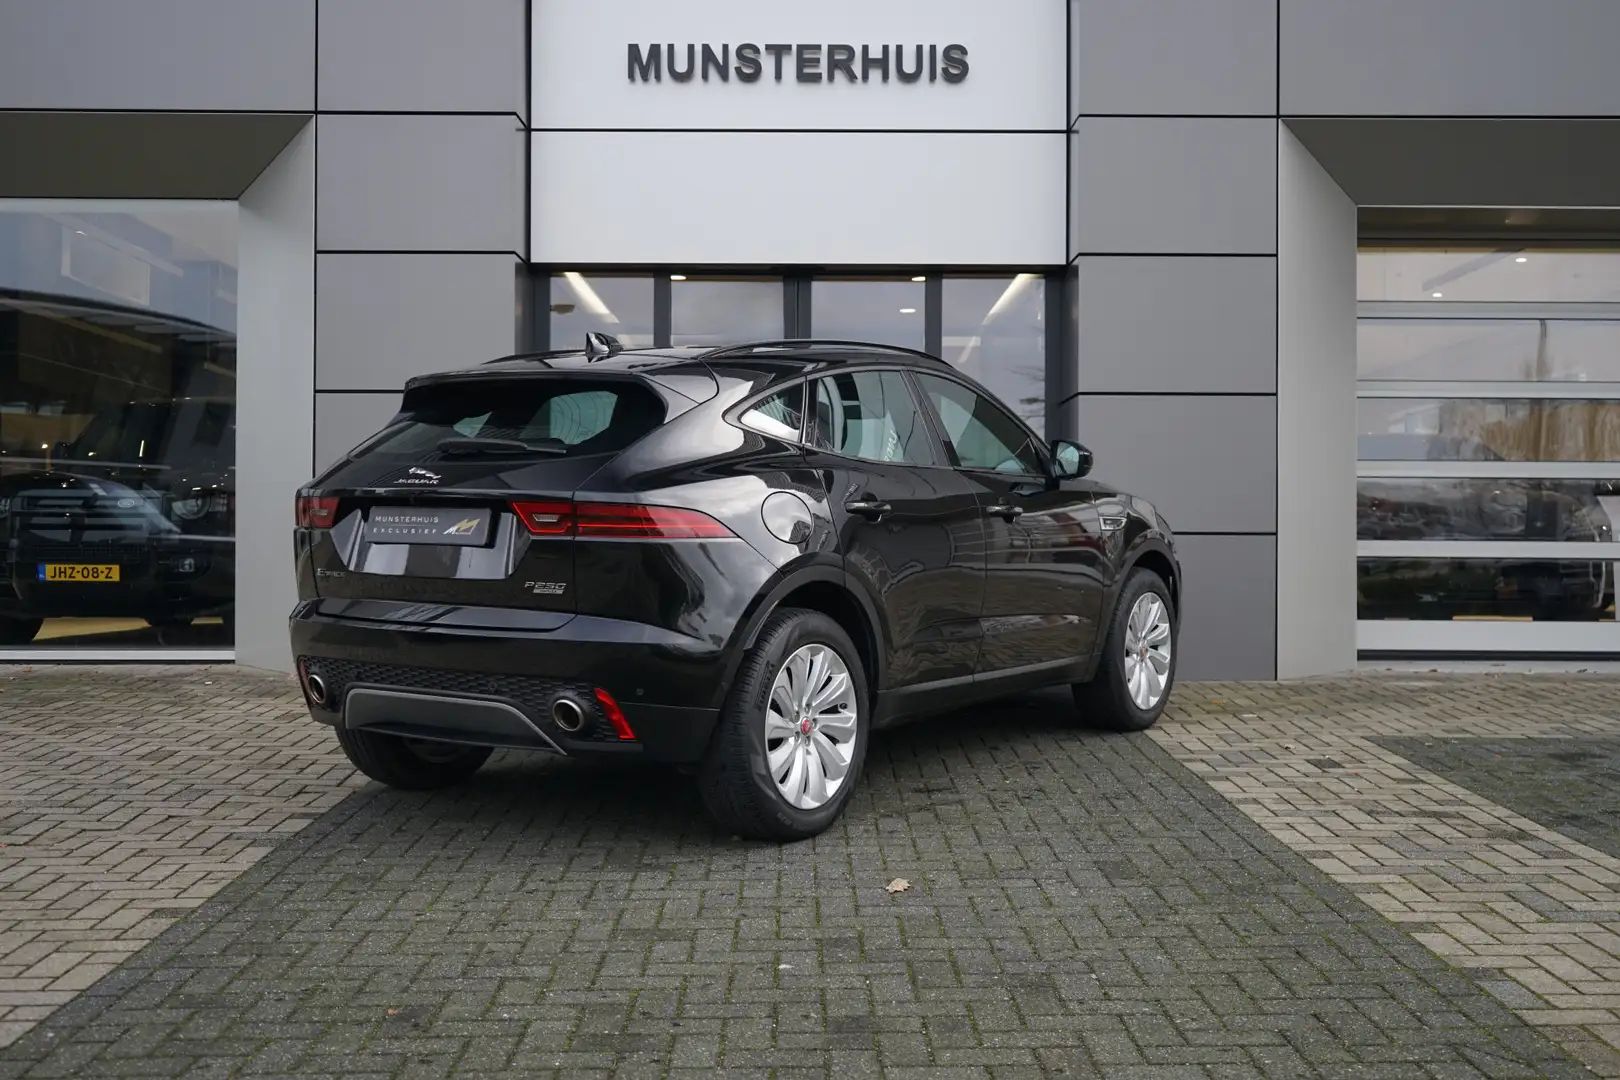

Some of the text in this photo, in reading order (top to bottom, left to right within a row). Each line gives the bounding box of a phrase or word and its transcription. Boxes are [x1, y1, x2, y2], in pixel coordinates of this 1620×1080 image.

[627, 43, 970, 83] MUNSTERHUIS
[374, 515, 440, 524] MUNSTERHUIS
[50, 566, 113, 579] JHZ-08-Z
[524, 581, 567, 590] P250
